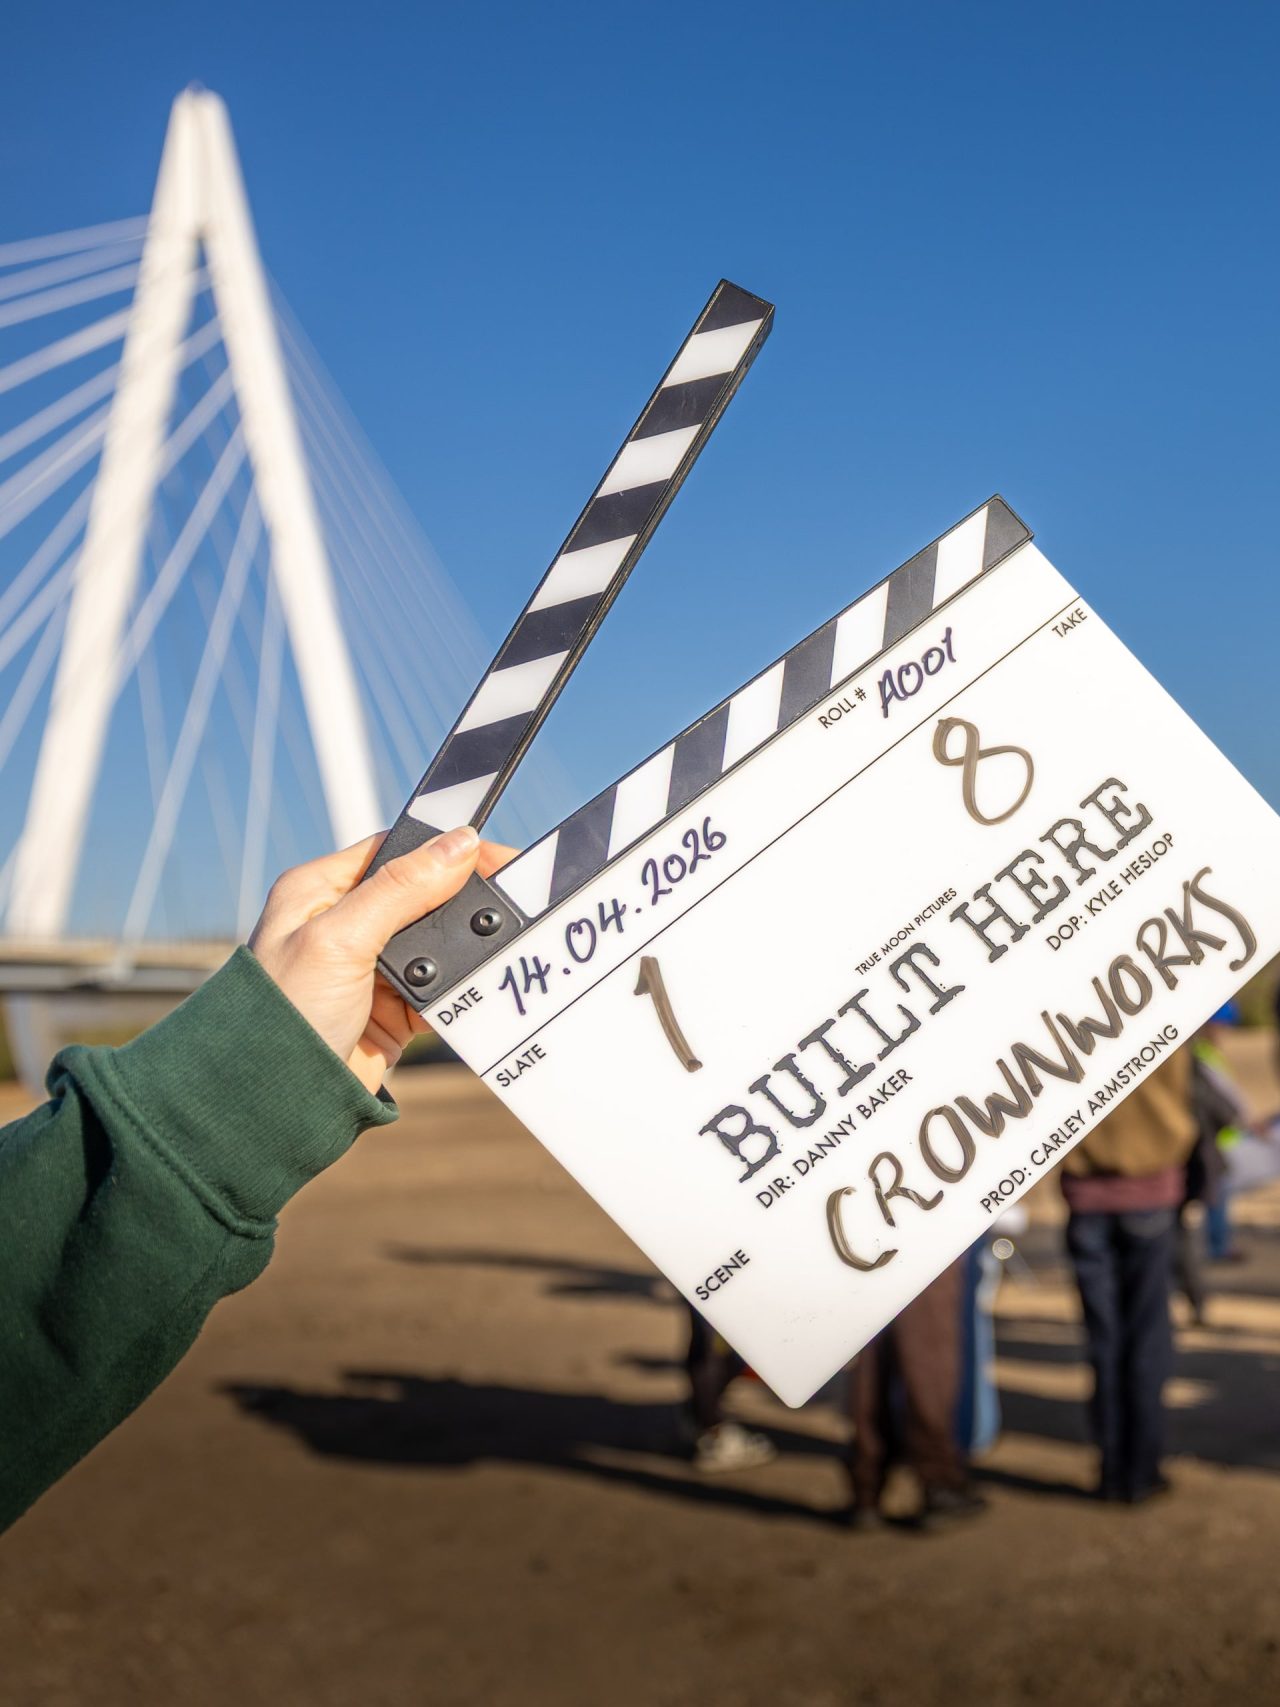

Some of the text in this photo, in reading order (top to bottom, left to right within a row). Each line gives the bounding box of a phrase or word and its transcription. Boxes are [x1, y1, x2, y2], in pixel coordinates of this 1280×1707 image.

[877, 626, 957, 719] A001
[1051, 607, 1088, 638] TAKE
[817, 697, 857, 729] ROLL
[932, 716, 1035, 827] 8
[498, 816, 727, 1016] 14.04.2026
[854, 887, 958, 976] TRUE MOON PICTURES
[1045, 832, 1174, 952] DOP: KYLE HESLOP
[436, 986, 484, 1027] DATE
[633, 955, 704, 1073] 1
[697, 777, 1154, 1184] BUILT HERE
[495, 1043, 547, 1088] SLATE
[825, 866, 1258, 1273] CROWNWORKS
[979, 1024, 1180, 1214] PROD: CARLEY ARMSTRONG
[755, 1068, 914, 1209] DIR: DANNY BAKER
[694, 1248, 751, 1302] SCENE
